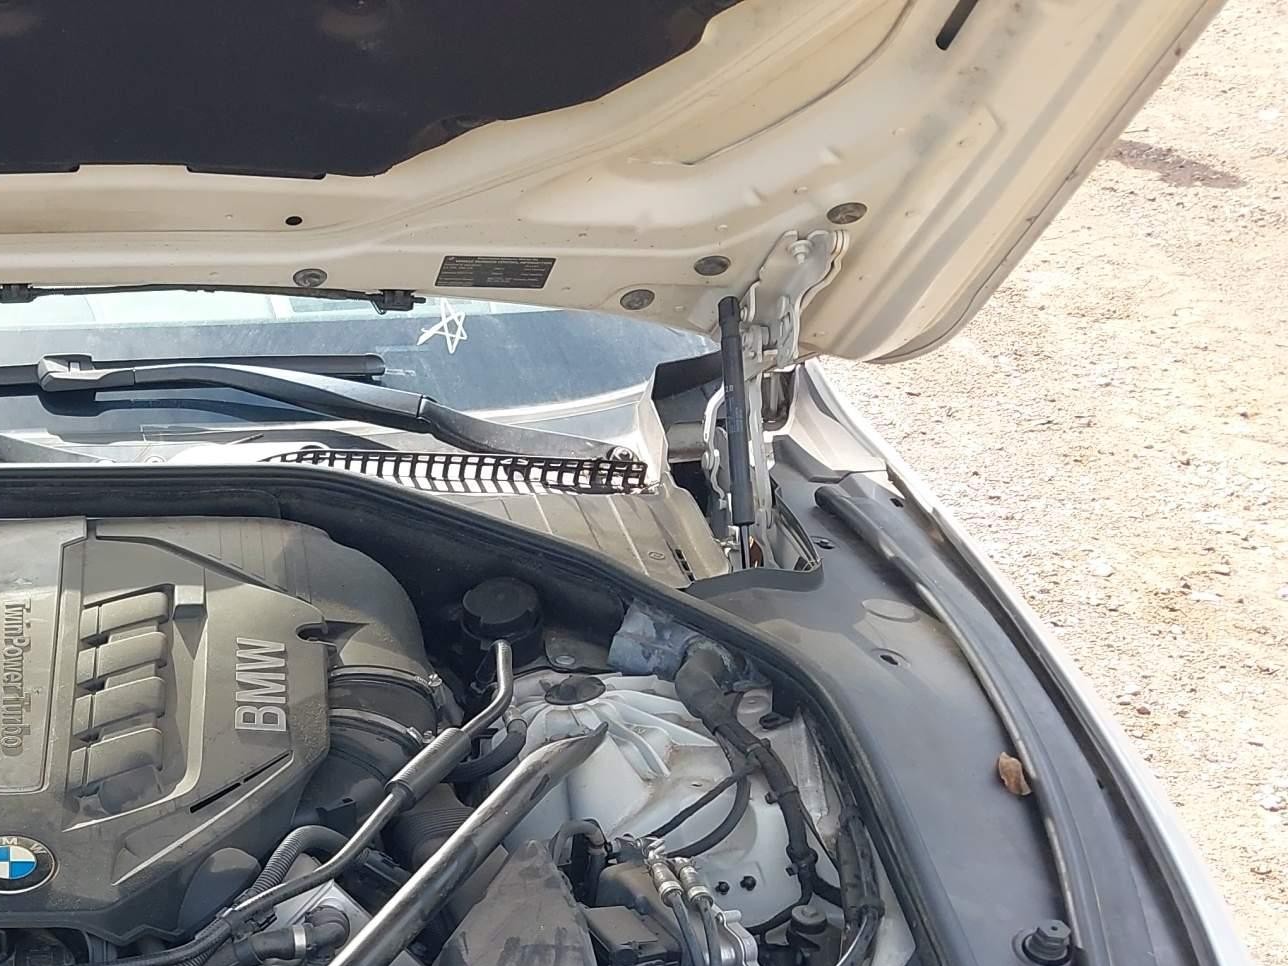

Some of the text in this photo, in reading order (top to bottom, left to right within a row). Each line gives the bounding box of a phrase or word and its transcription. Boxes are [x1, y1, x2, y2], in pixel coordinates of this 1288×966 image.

[0, 599, 32, 756] TwinPower Turbo
[234, 637, 286, 732] BMW
